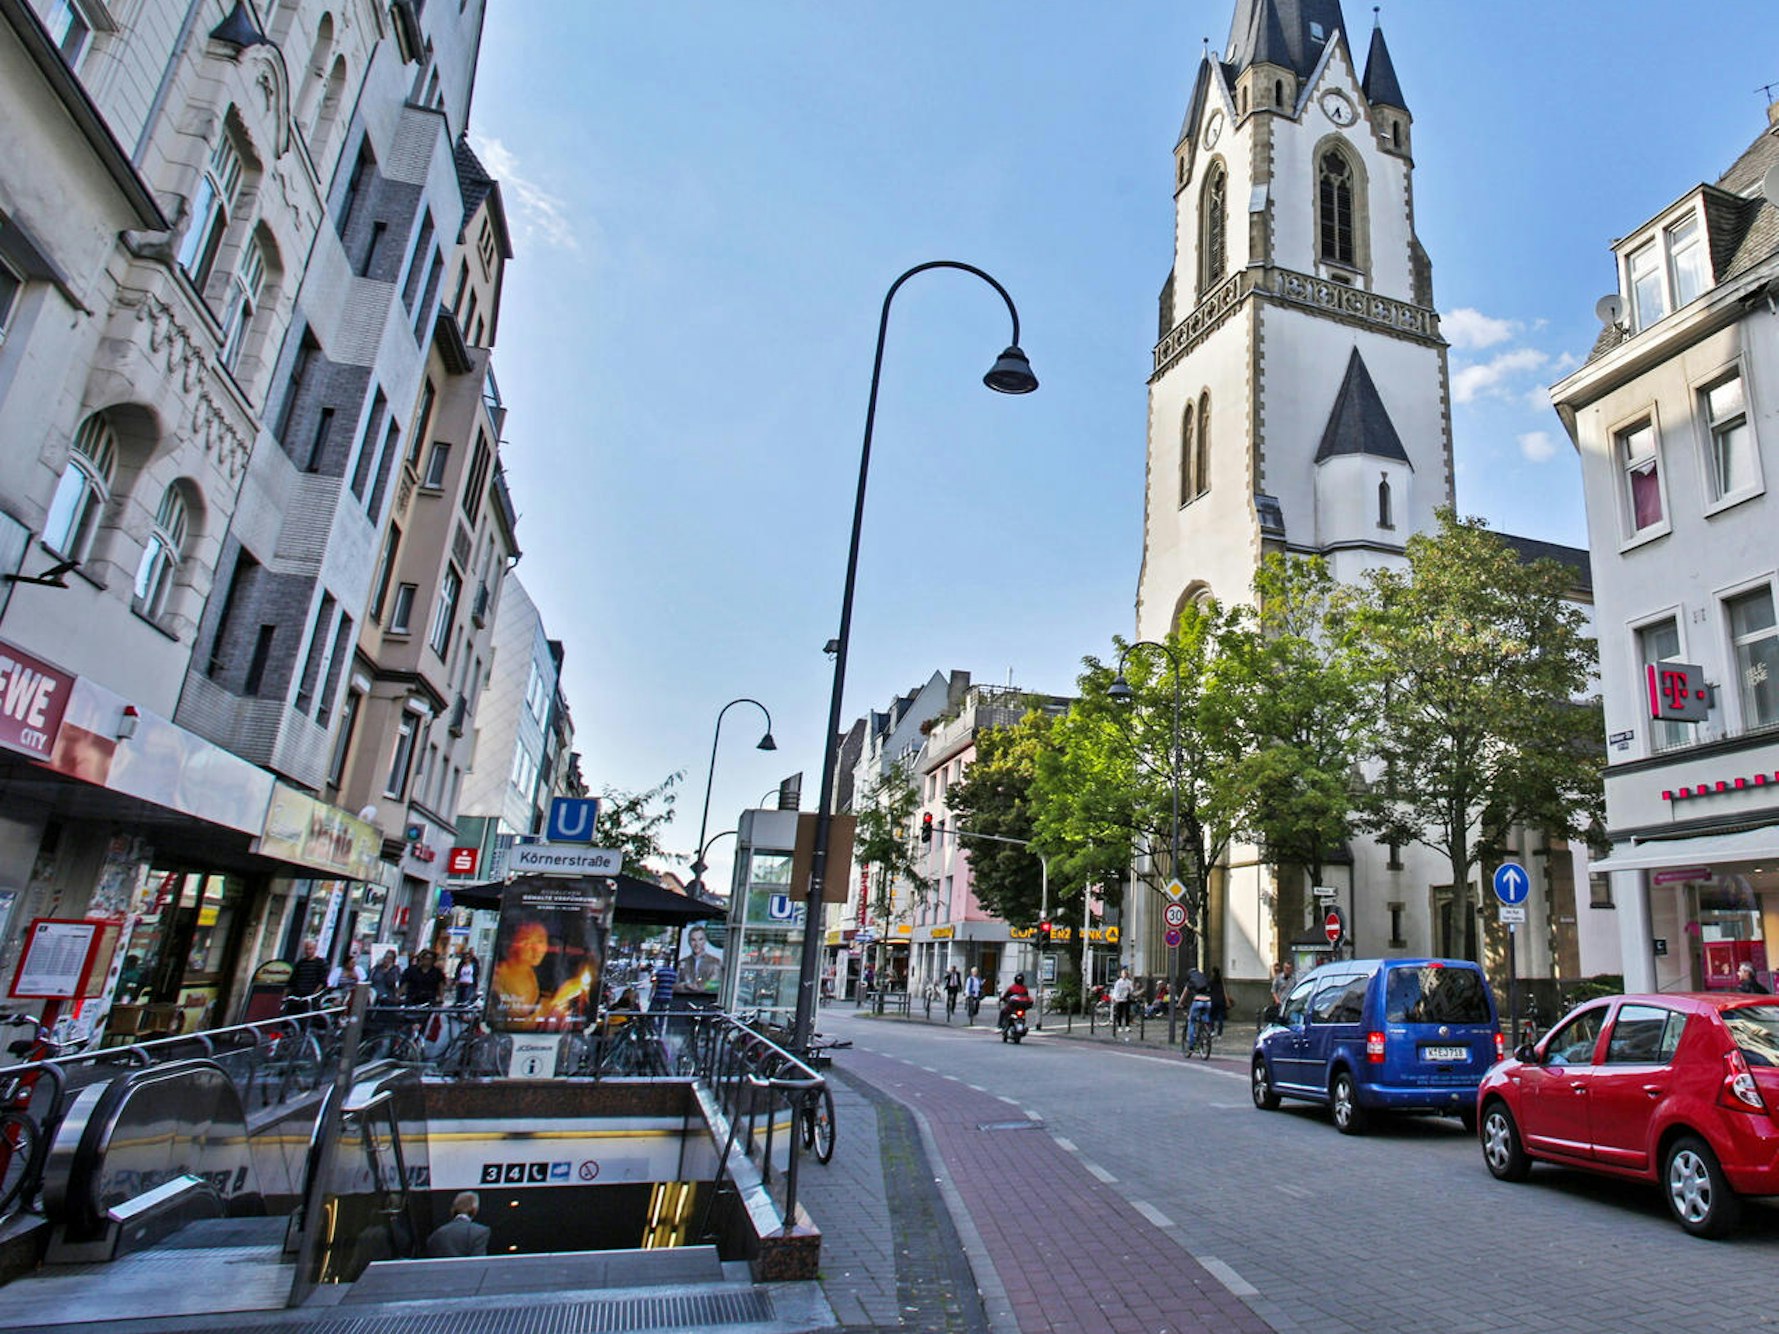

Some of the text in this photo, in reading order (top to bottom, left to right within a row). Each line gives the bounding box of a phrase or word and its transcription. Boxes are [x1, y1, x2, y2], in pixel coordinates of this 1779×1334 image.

[21, 727, 48, 750] CITY
[557, 802, 589, 836] U
[520, 851, 611, 868] Körnerstraße
[771, 894, 793, 919] U
[1169, 909, 1182, 921] 30
[485, 1166, 521, 1181] 3 4
